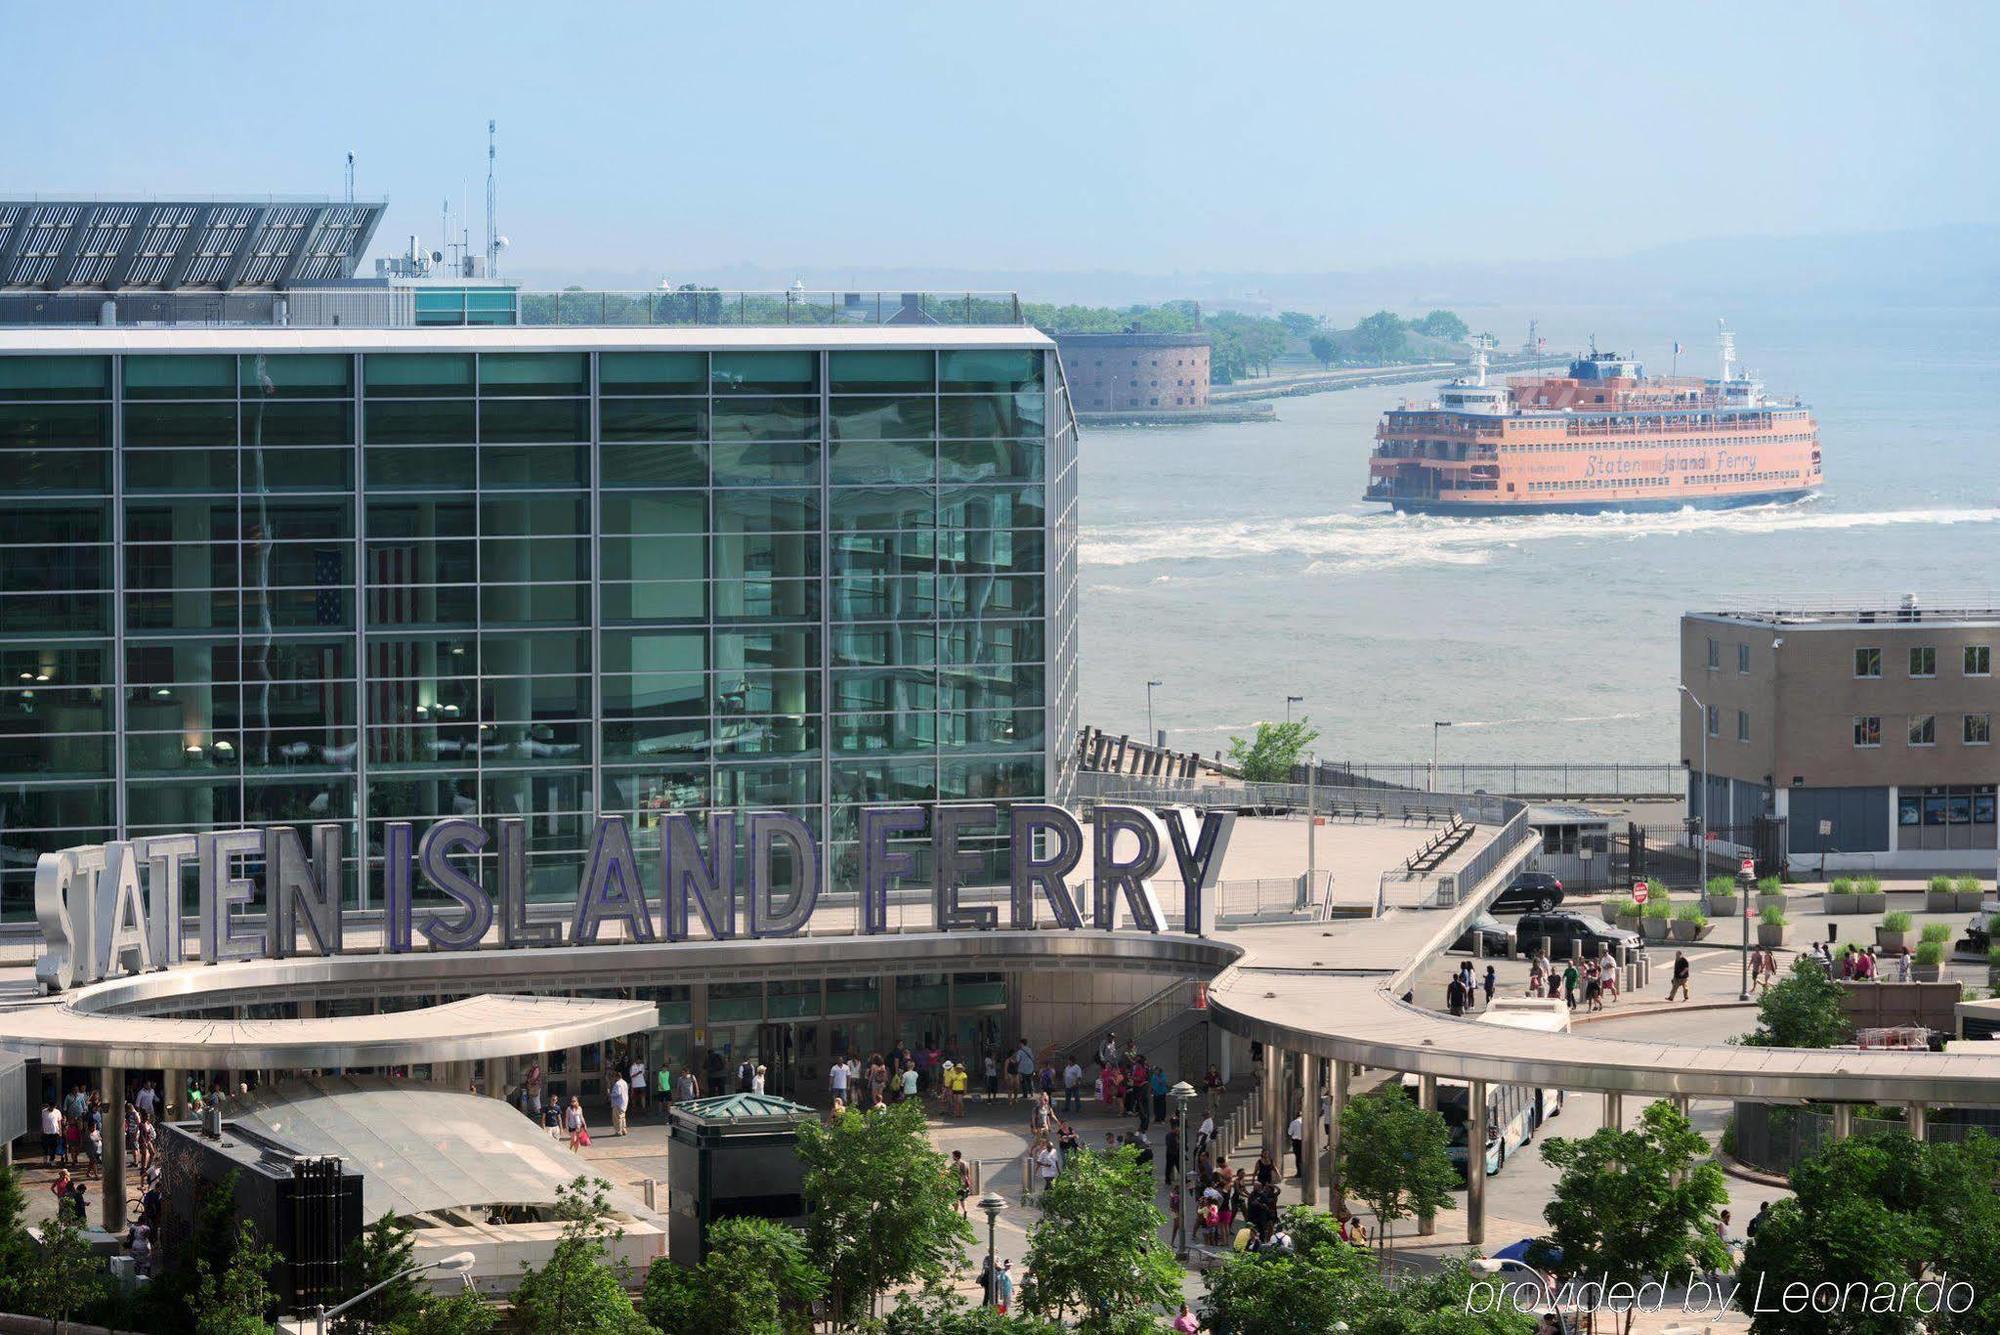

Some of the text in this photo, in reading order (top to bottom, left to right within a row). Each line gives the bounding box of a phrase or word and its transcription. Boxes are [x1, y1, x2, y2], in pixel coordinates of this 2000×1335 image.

[1584, 455, 1641, 477] Staten
[1660, 450, 1706, 474] Island
[1715, 450, 1758, 473] Ferry
[34, 803, 1237, 994] STATEN ISLAND FERRY
